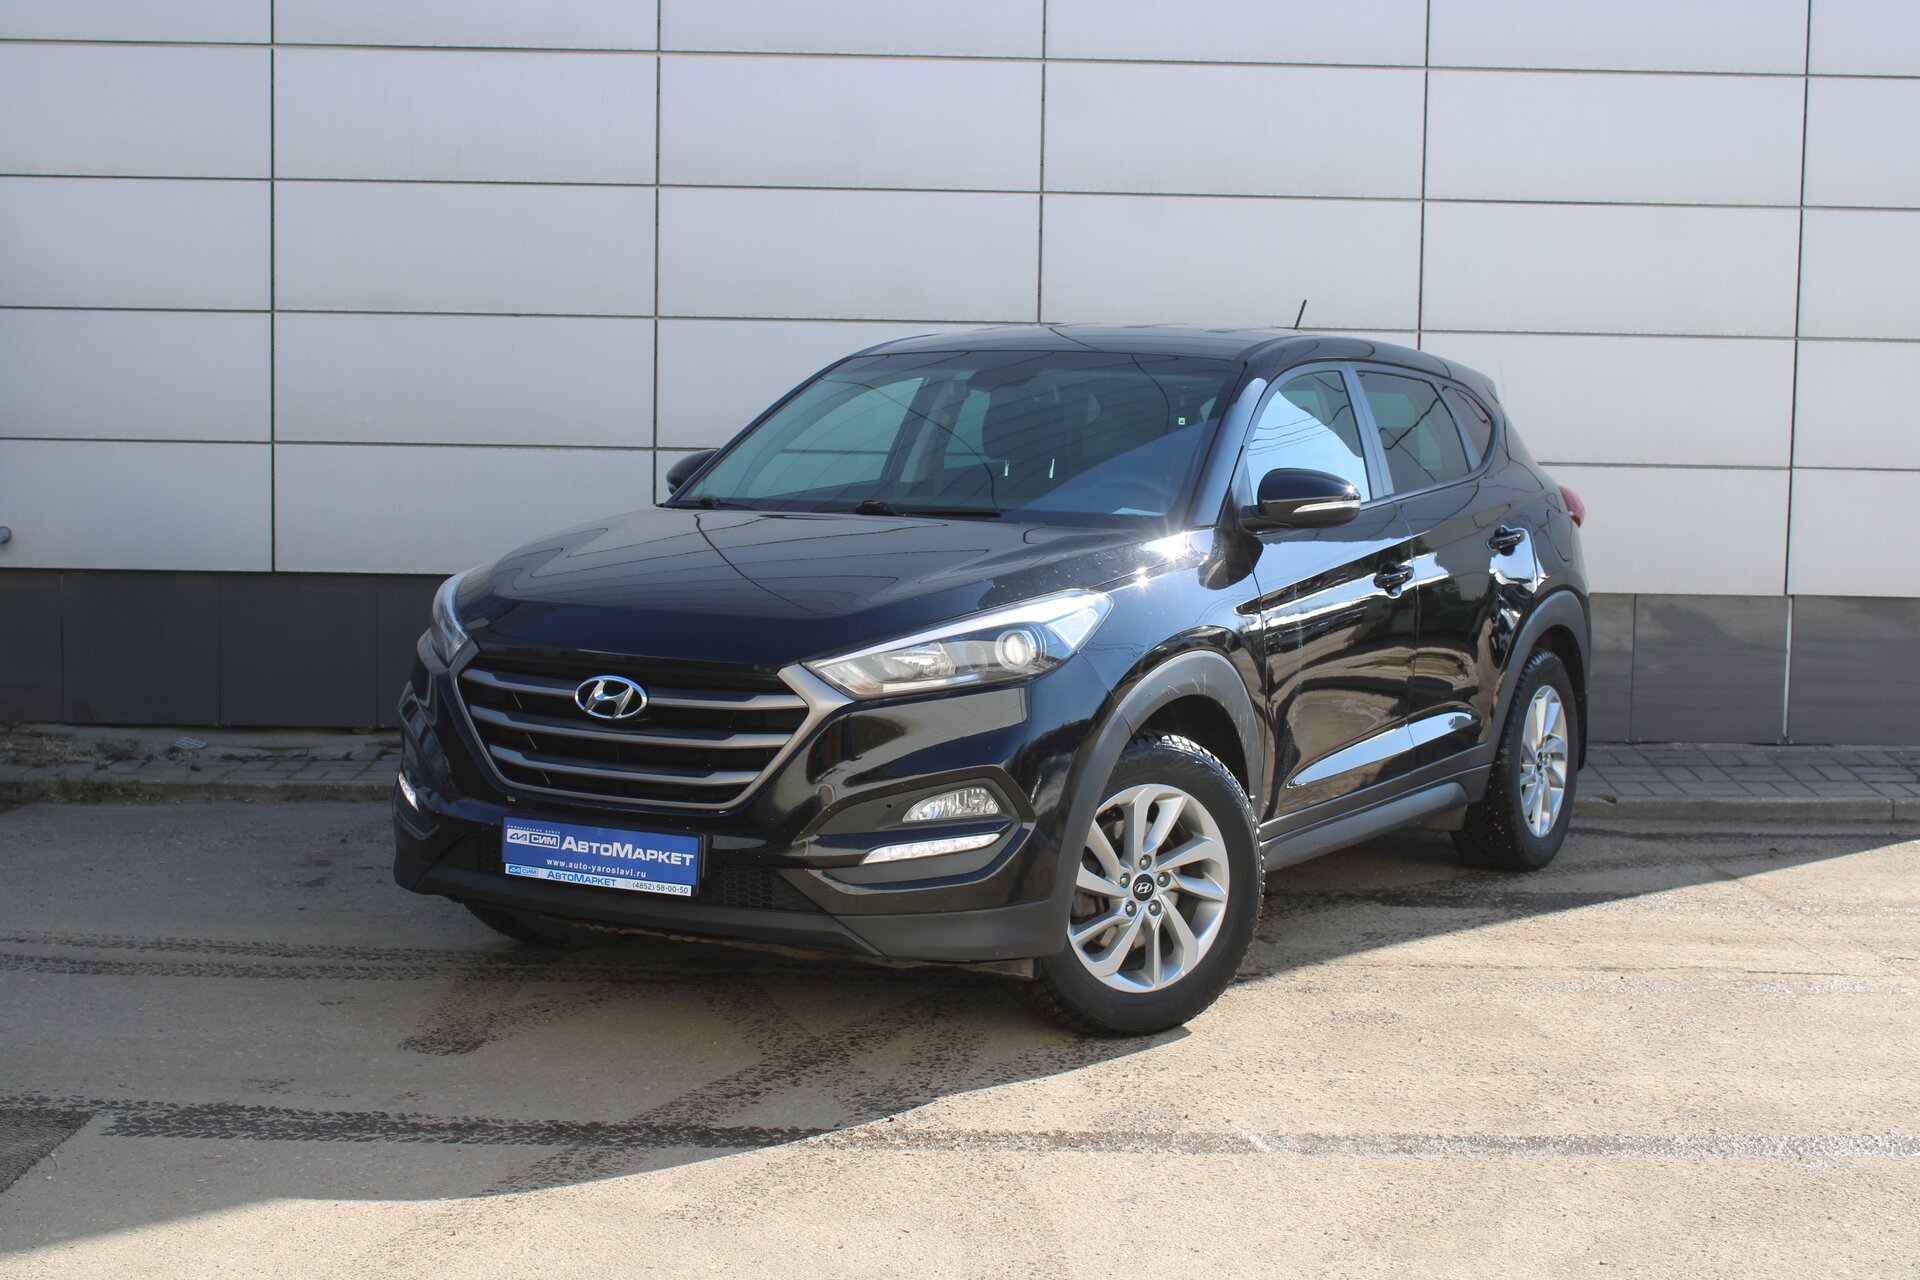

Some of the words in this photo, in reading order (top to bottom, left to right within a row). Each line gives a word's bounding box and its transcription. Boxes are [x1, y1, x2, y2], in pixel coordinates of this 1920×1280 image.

[531, 835, 557, 846] СИМ
[546, 858, 647, 878] www.auto-yaroslavl.ru
[521, 868, 537, 876] СИМ
[632, 881, 655, 891] (4852)
[656, 884, 689, 894] 58-00-50
